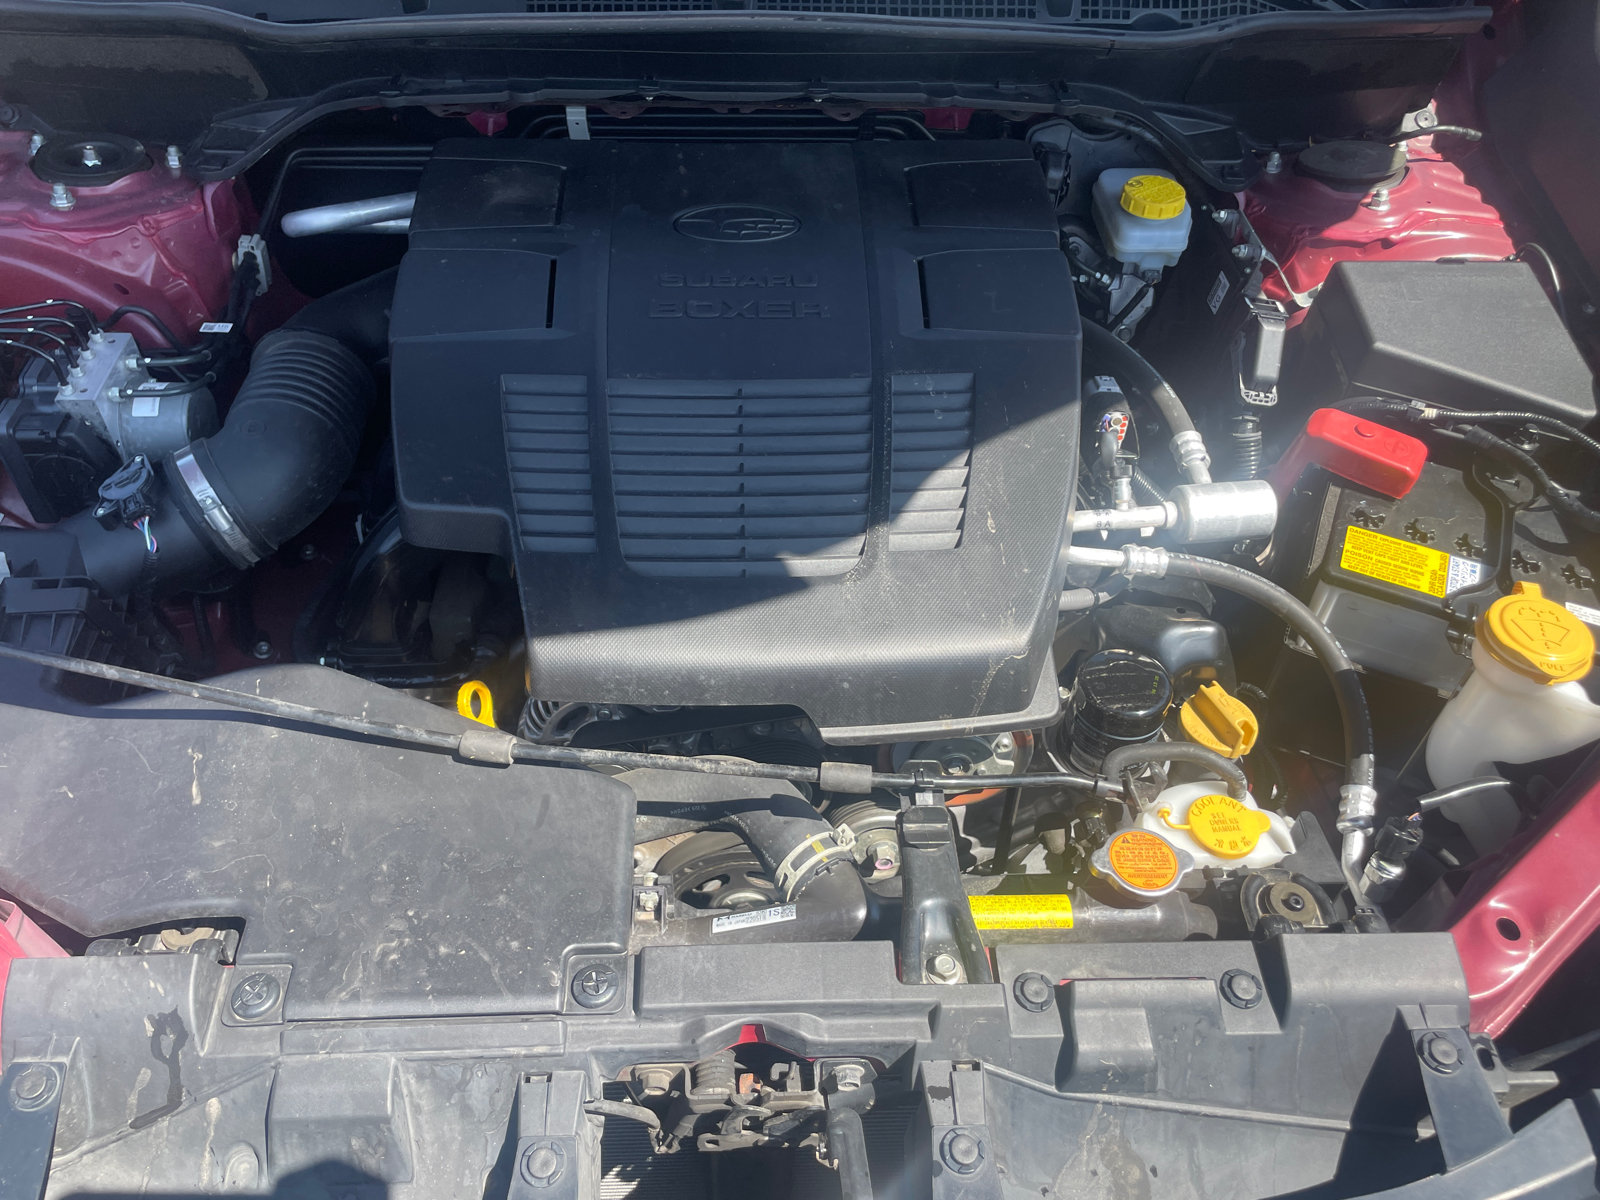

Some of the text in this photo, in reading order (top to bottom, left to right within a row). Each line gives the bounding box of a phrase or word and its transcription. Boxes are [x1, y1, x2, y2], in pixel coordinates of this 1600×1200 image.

[659, 272, 818, 288] SUBARU
[648, 299, 831, 319] BOXER
[1349, 527, 1378, 539] DANGER
[1344, 549, 1373, 560] POISON
[1191, 796, 1246, 817] COOLANT
[1212, 824, 1242, 833] MANUAL
